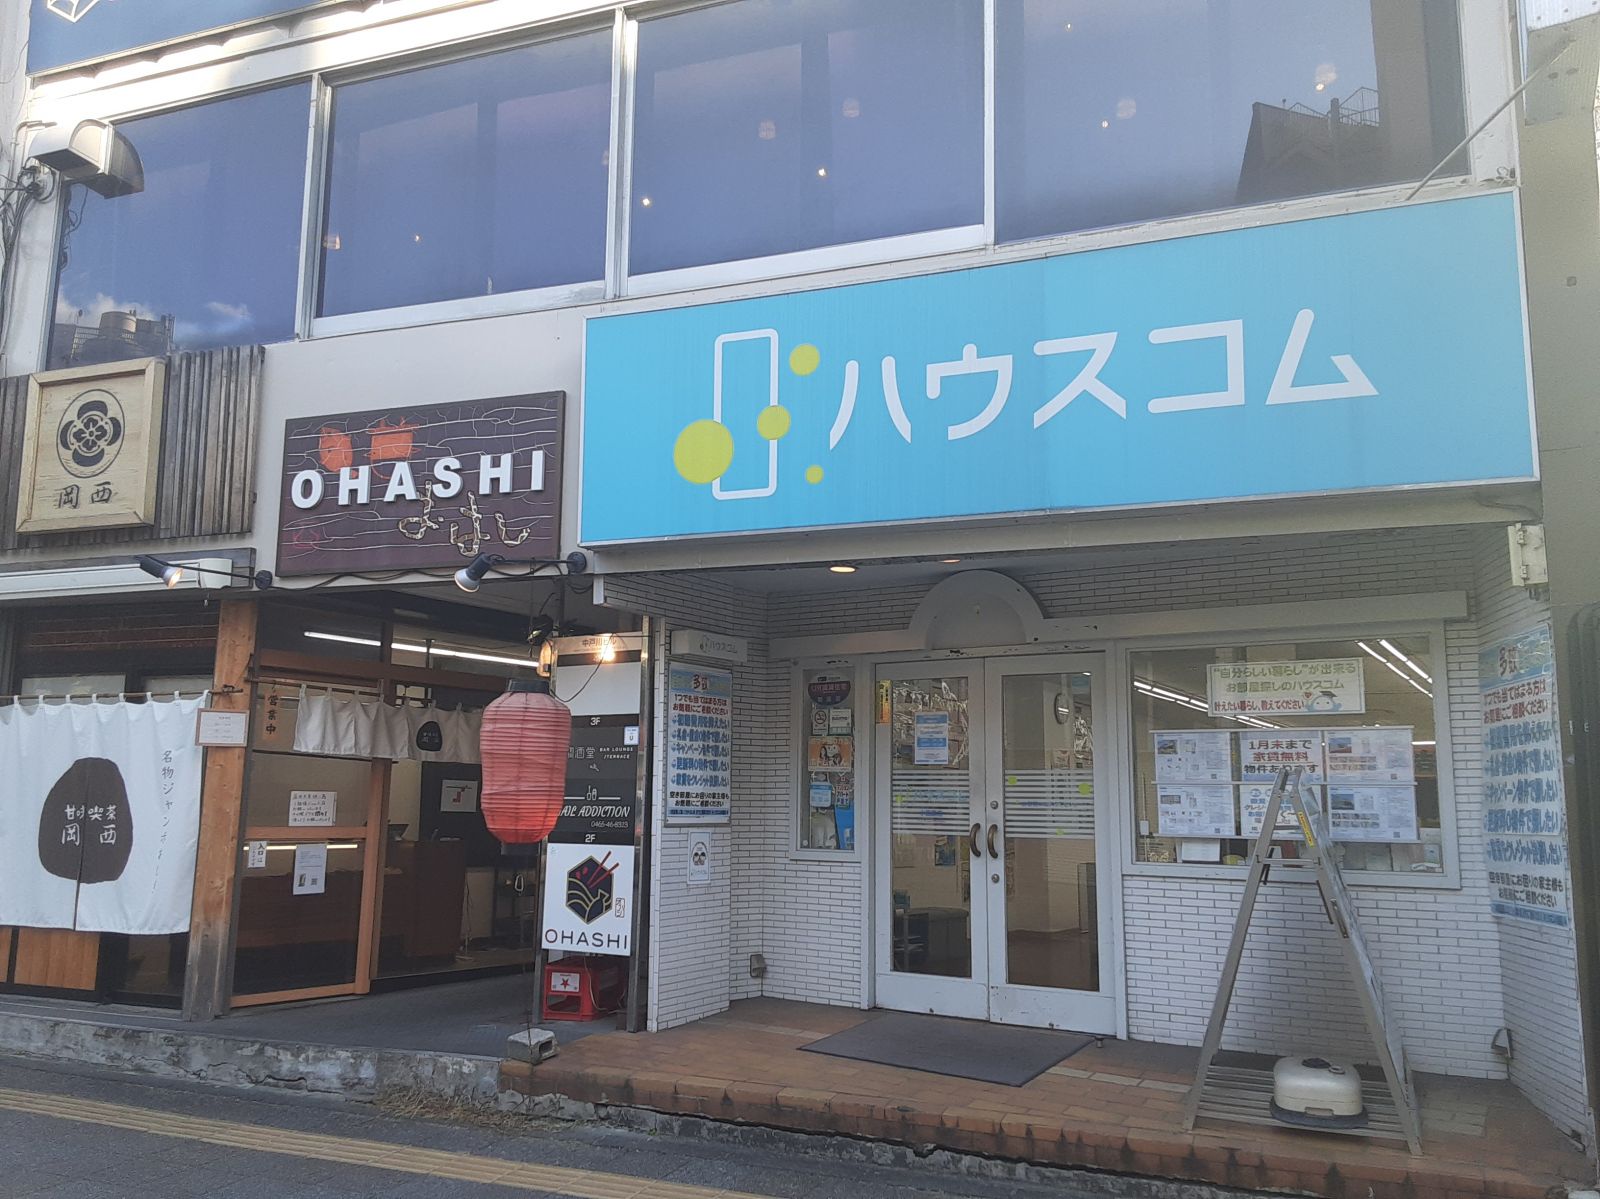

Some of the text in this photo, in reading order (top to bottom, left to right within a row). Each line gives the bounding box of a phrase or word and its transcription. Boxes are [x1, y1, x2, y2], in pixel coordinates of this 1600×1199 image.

[828, 308, 1379, 451] ハウスコム
[290, 450, 546, 510] OHASHI
[58, 480, 114, 509] 岡西
[1226, 680, 1345, 693] お部屋探しのハウスコム
[265, 694, 279, 735] 営業中
[590, 717, 600, 726] 3F
[1248, 739, 1312, 750] 1月末まで
[1253, 751, 1309, 761] 家賃無料
[1243, 764, 1319, 774] 物件ありす
[64, 804, 118, 821] 甘味喫茶
[558, 805, 631, 818] AIL ADDICTION
[61, 822, 118, 846] 岡西
[585, 834, 596, 842] 2F
[545, 929, 628, 949] OHASHI
